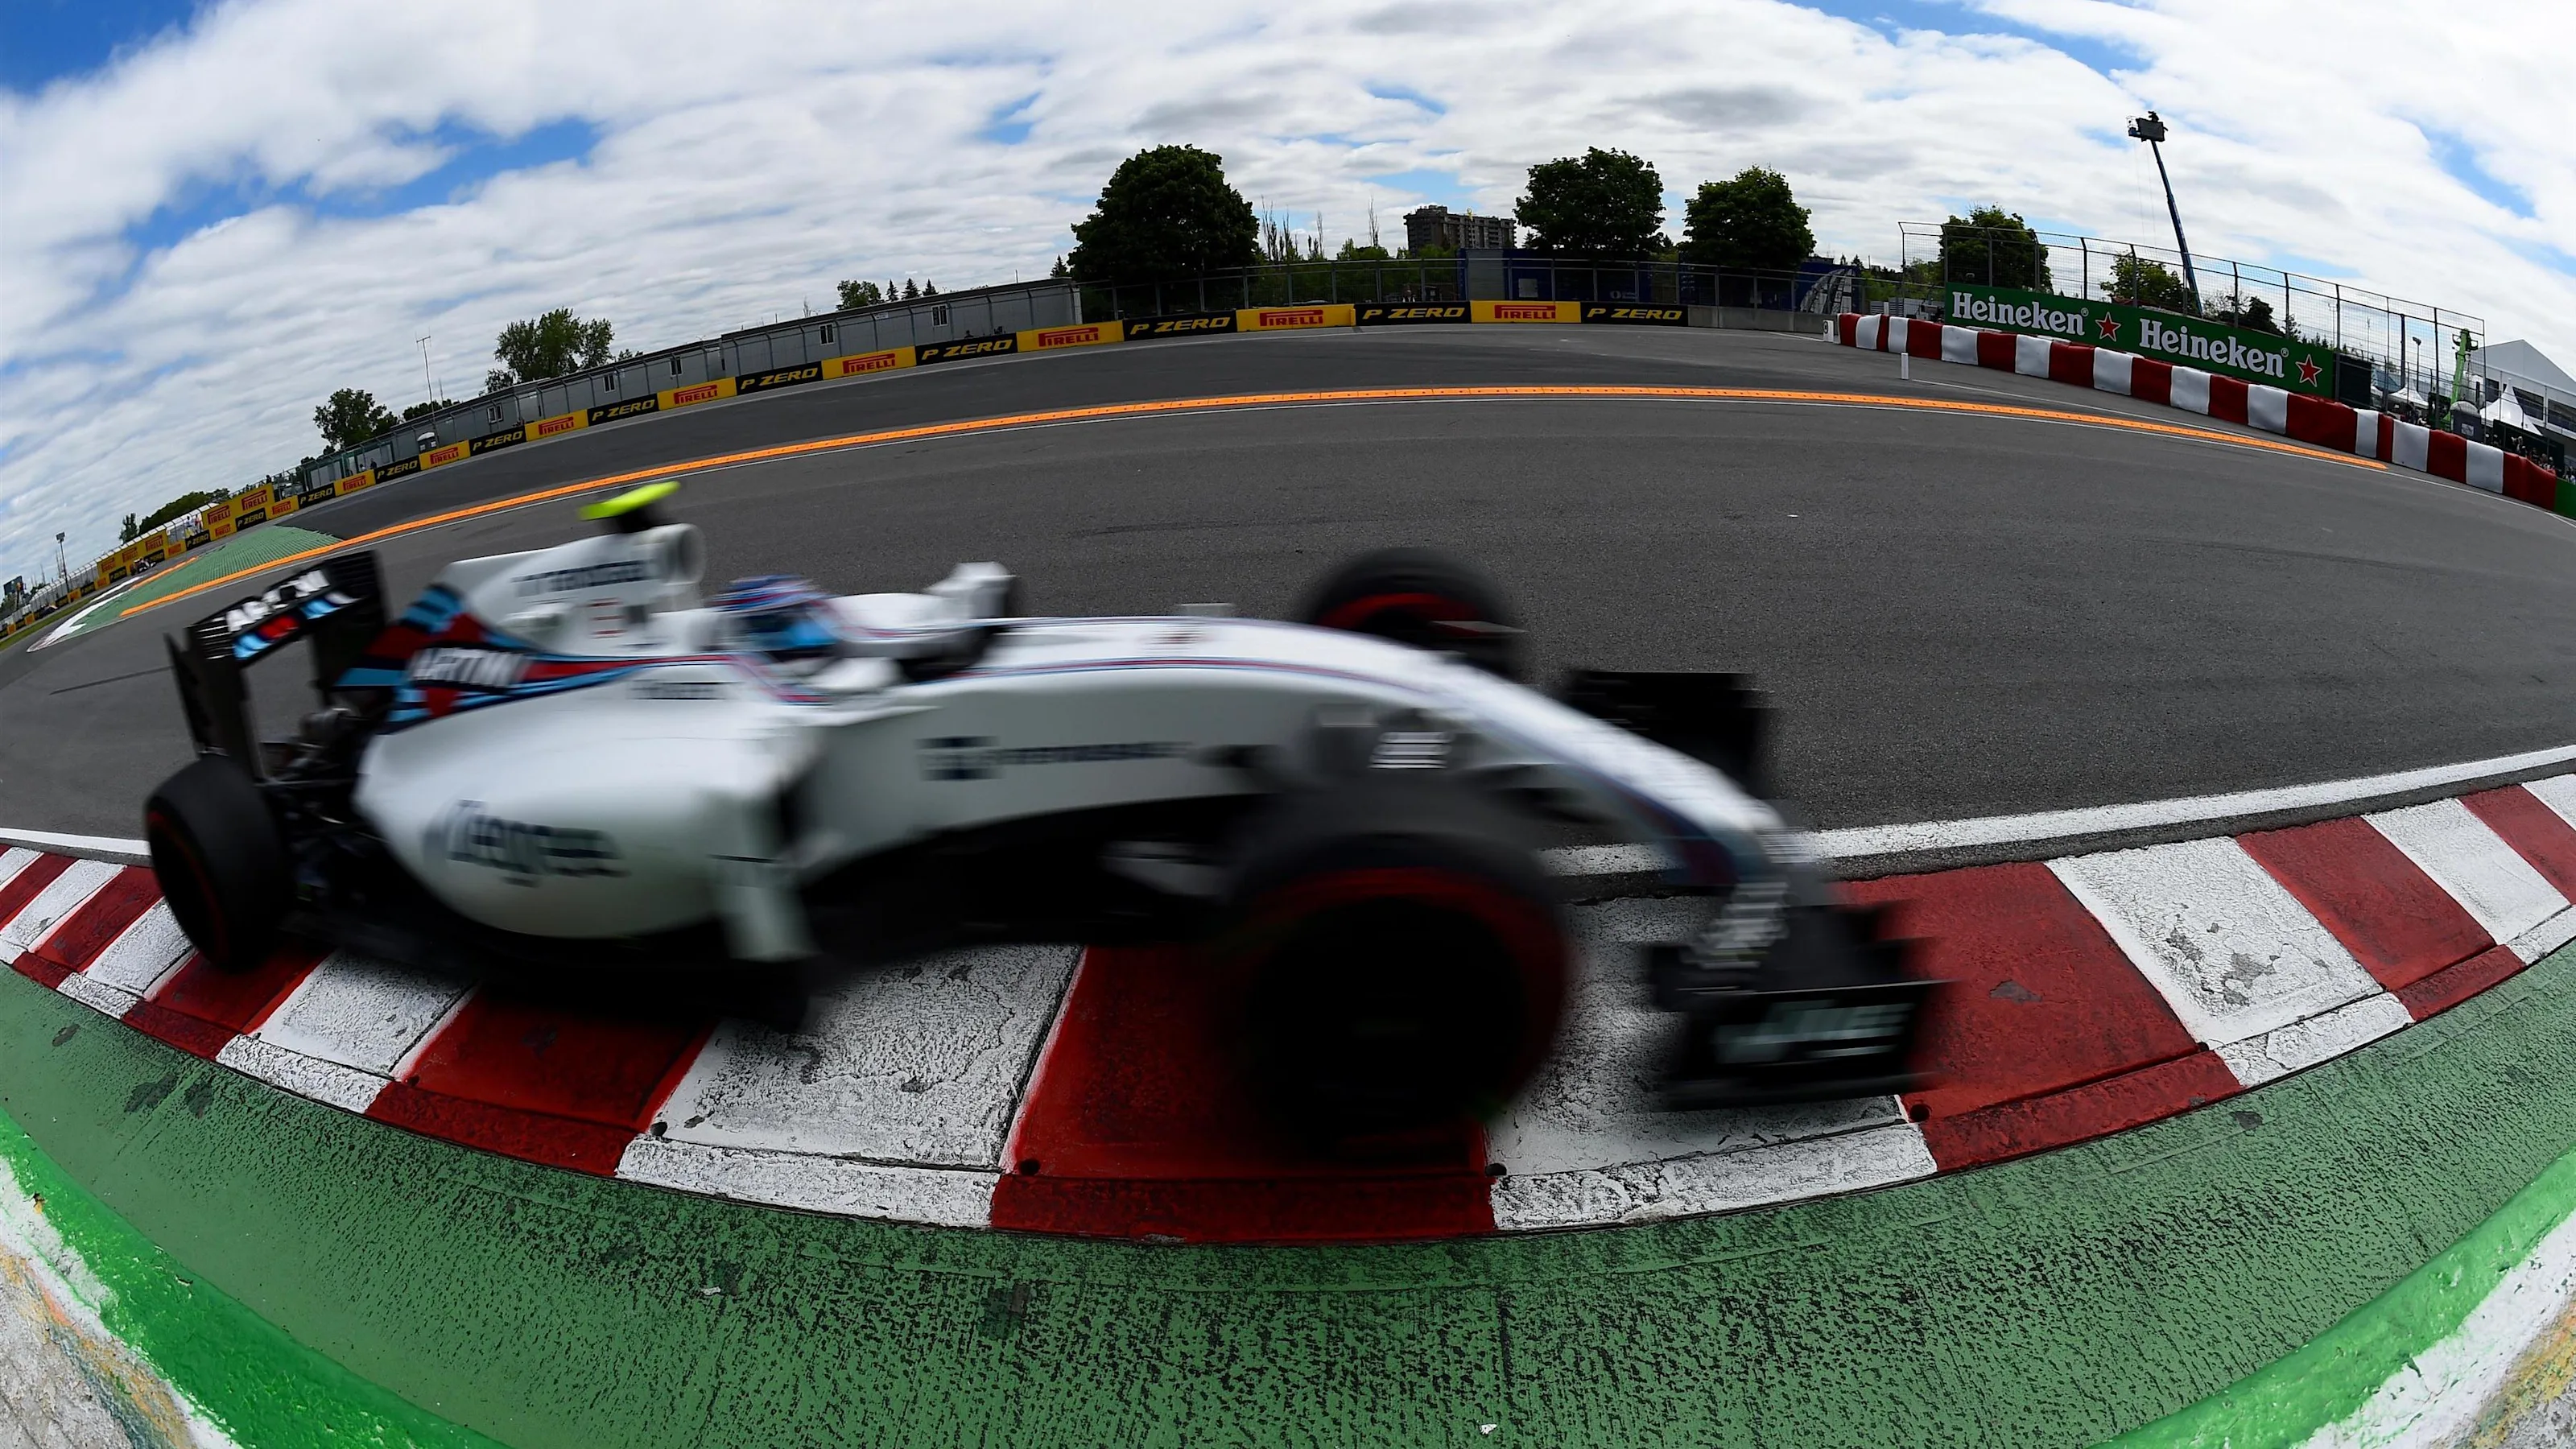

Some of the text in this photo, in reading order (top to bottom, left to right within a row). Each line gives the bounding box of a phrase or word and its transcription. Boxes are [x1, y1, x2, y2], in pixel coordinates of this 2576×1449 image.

[1259, 310, 1323, 327] PIRELLI
[1363, 308, 1464, 320] P ZERO
[1493, 304, 1555, 320] PIRELLI
[1587, 308, 1682, 320] P ZERO
[1130, 317, 1230, 335] P ZERO
[1038, 327, 1098, 347] PIRELLI
[921, 339, 1012, 361] P ZERO
[842, 353, 895, 374] PIRELLI
[740, 366, 818, 390] P ZERO
[674, 385, 717, 404] PIRELLI
[591, 399, 655, 422] P ZERO
[539, 416, 574, 436] PIRELLI
[472, 431, 522, 452] P ZERO
[430, 447, 459, 465] PIRELLI
[377, 460, 418, 479] P ZERO
[344, 476, 366, 491] PIRELLI
[242, 489, 268, 510] PIRELLI
[300, 488, 333, 505] P ZERO
[208, 505, 231, 525] PIRELLI
[237, 511, 264, 528] P ZERO
